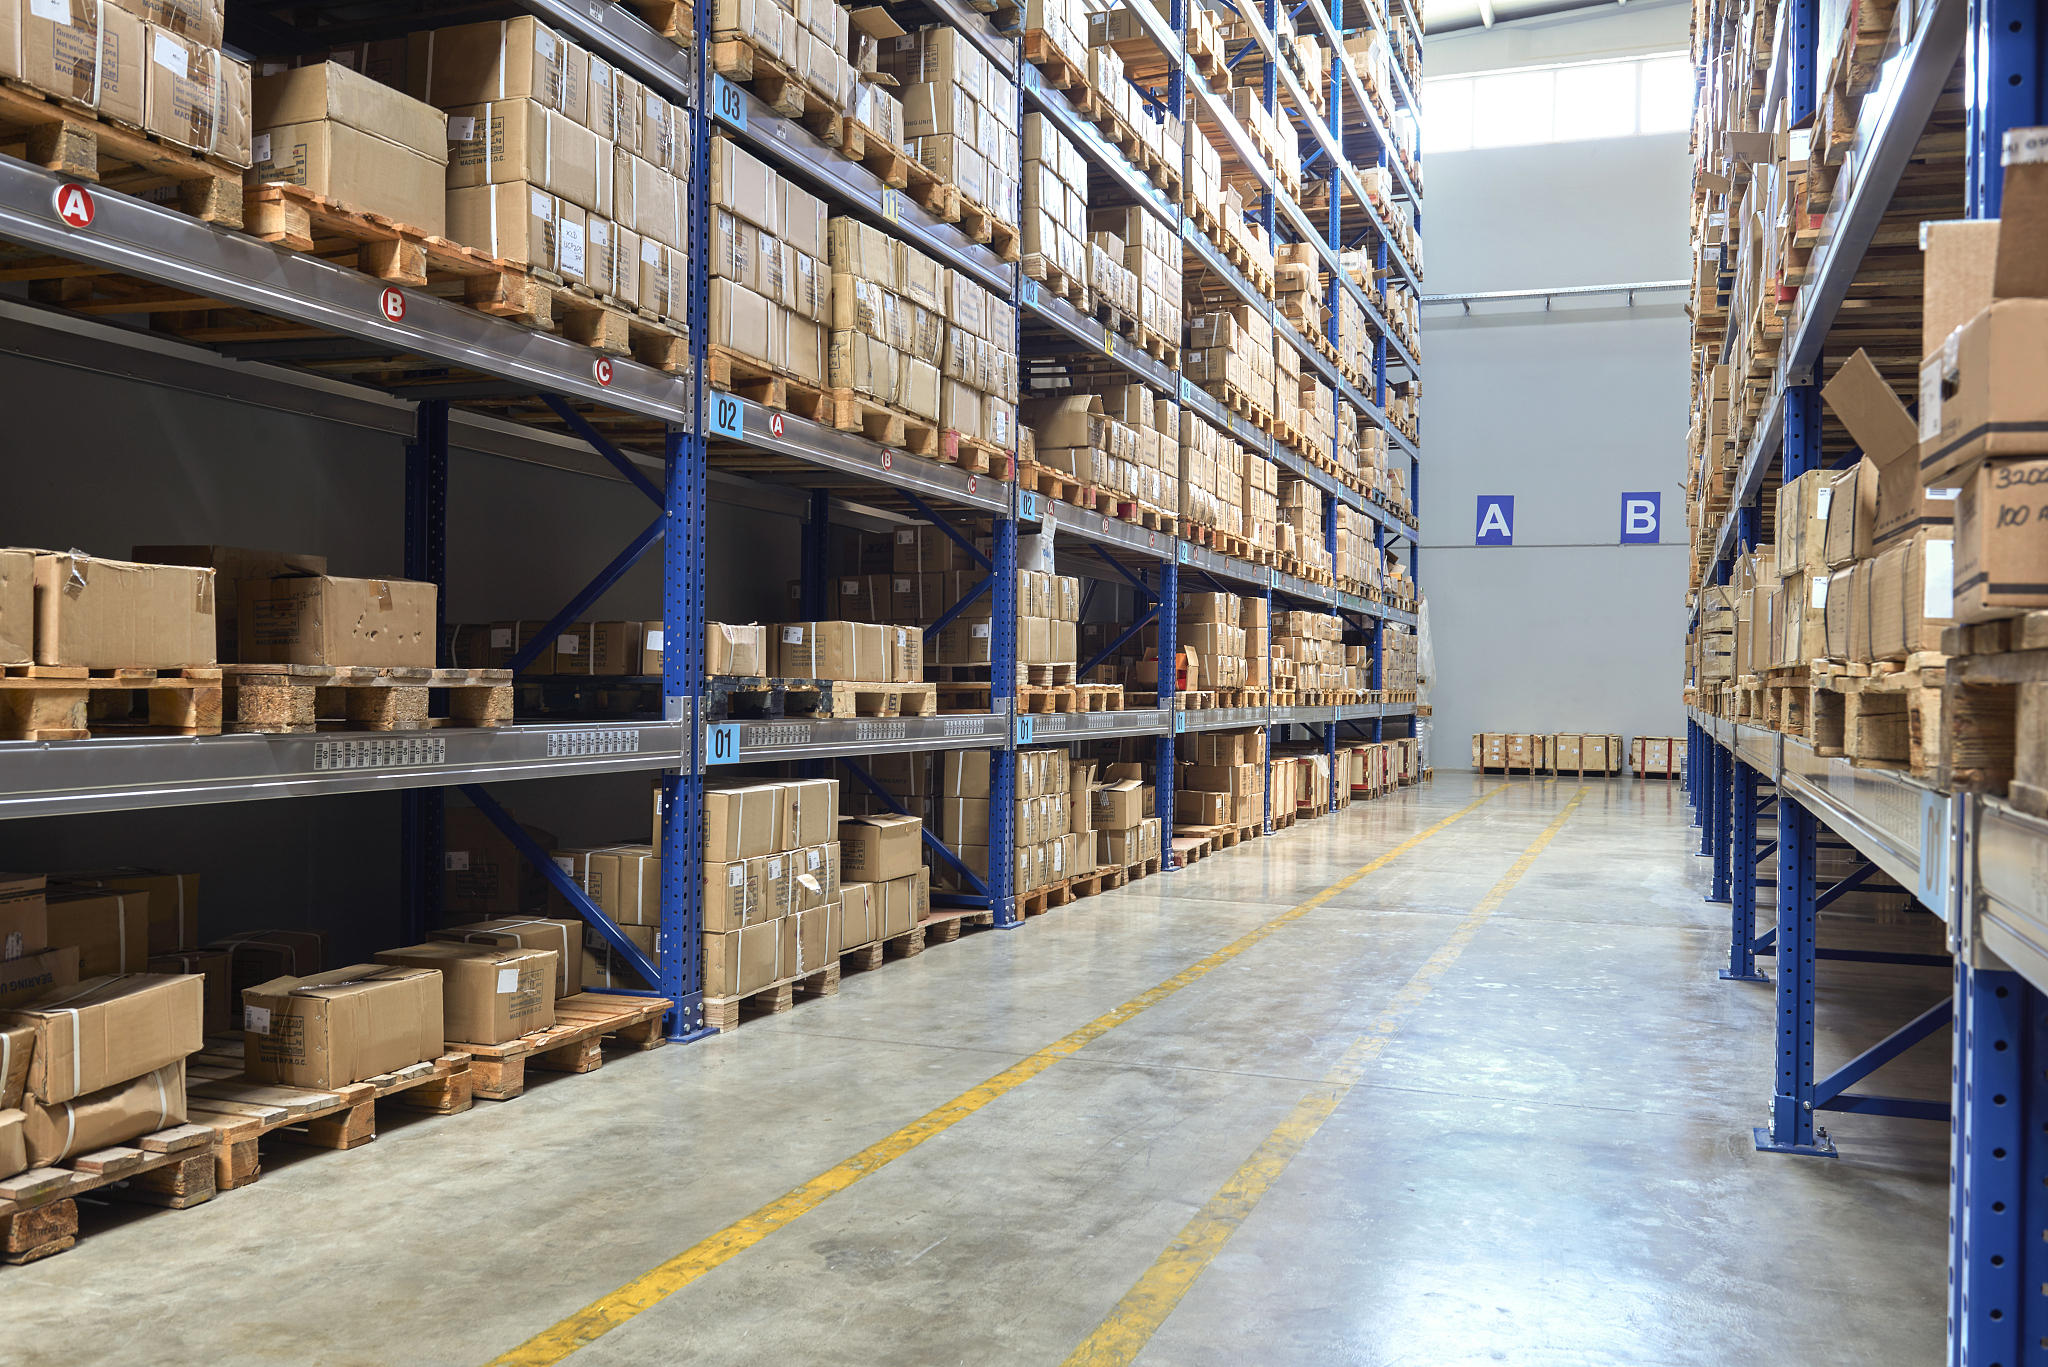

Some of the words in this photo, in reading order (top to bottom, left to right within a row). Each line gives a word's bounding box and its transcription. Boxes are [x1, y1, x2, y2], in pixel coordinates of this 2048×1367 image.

[142, 1, 164, 14] MADE
[56, 28, 84, 45] Quantity
[56, 39, 68, 49] Net
[68, 44, 89, 56] weight
[55, 63, 78, 78] MADE
[80, 72, 88, 82] IN
[811, 69, 826, 86] BEARING
[722, 85, 740, 120] 03
[174, 109, 193, 122] MADE
[63, 189, 88, 222] A
[886, 190, 896, 218] 11
[1026, 281, 1034, 303] 03
[388, 292, 402, 316] B
[599, 361, 610, 381] C
[719, 399, 736, 431] 02
[774, 416, 782, 434] A
[885, 452, 891, 467] B
[970, 478, 975, 491] C
[1024, 495, 1032, 516] 02
[1050, 505, 1054, 514] A
[1104, 521, 1108, 531] B
[1478, 504, 1511, 537] A
[1626, 500, 1656, 534] B
[1996, 504, 2030, 529] 100
[1021, 720, 1029, 740] 01
[716, 729, 731, 758] 01
[323, 750, 328, 760] 00
[338, 750, 342, 758] 01
[351, 749, 356, 758] 02
[1926, 806, 1941, 896] 01
[10, 973, 53, 992] BEARING
[510, 1011, 521, 1019] MADE
